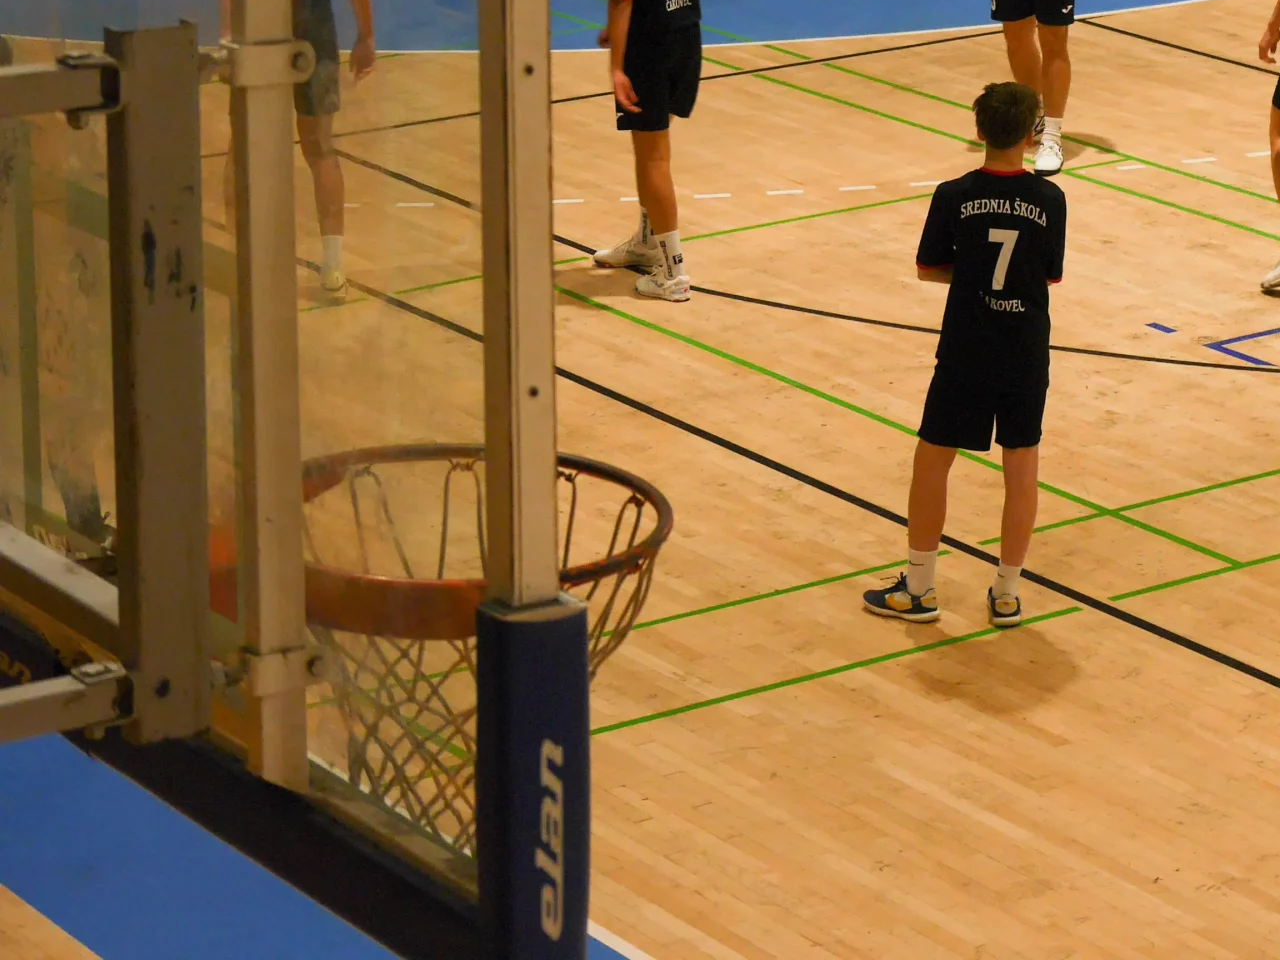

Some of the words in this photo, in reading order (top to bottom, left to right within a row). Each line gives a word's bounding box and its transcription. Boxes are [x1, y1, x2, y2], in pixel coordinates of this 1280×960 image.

[960, 198, 1012, 219] SREDNJA
[1013, 197, 1047, 227] ŠKOLA
[988, 228, 1020, 291] 7
[535, 738, 565, 941] elan
